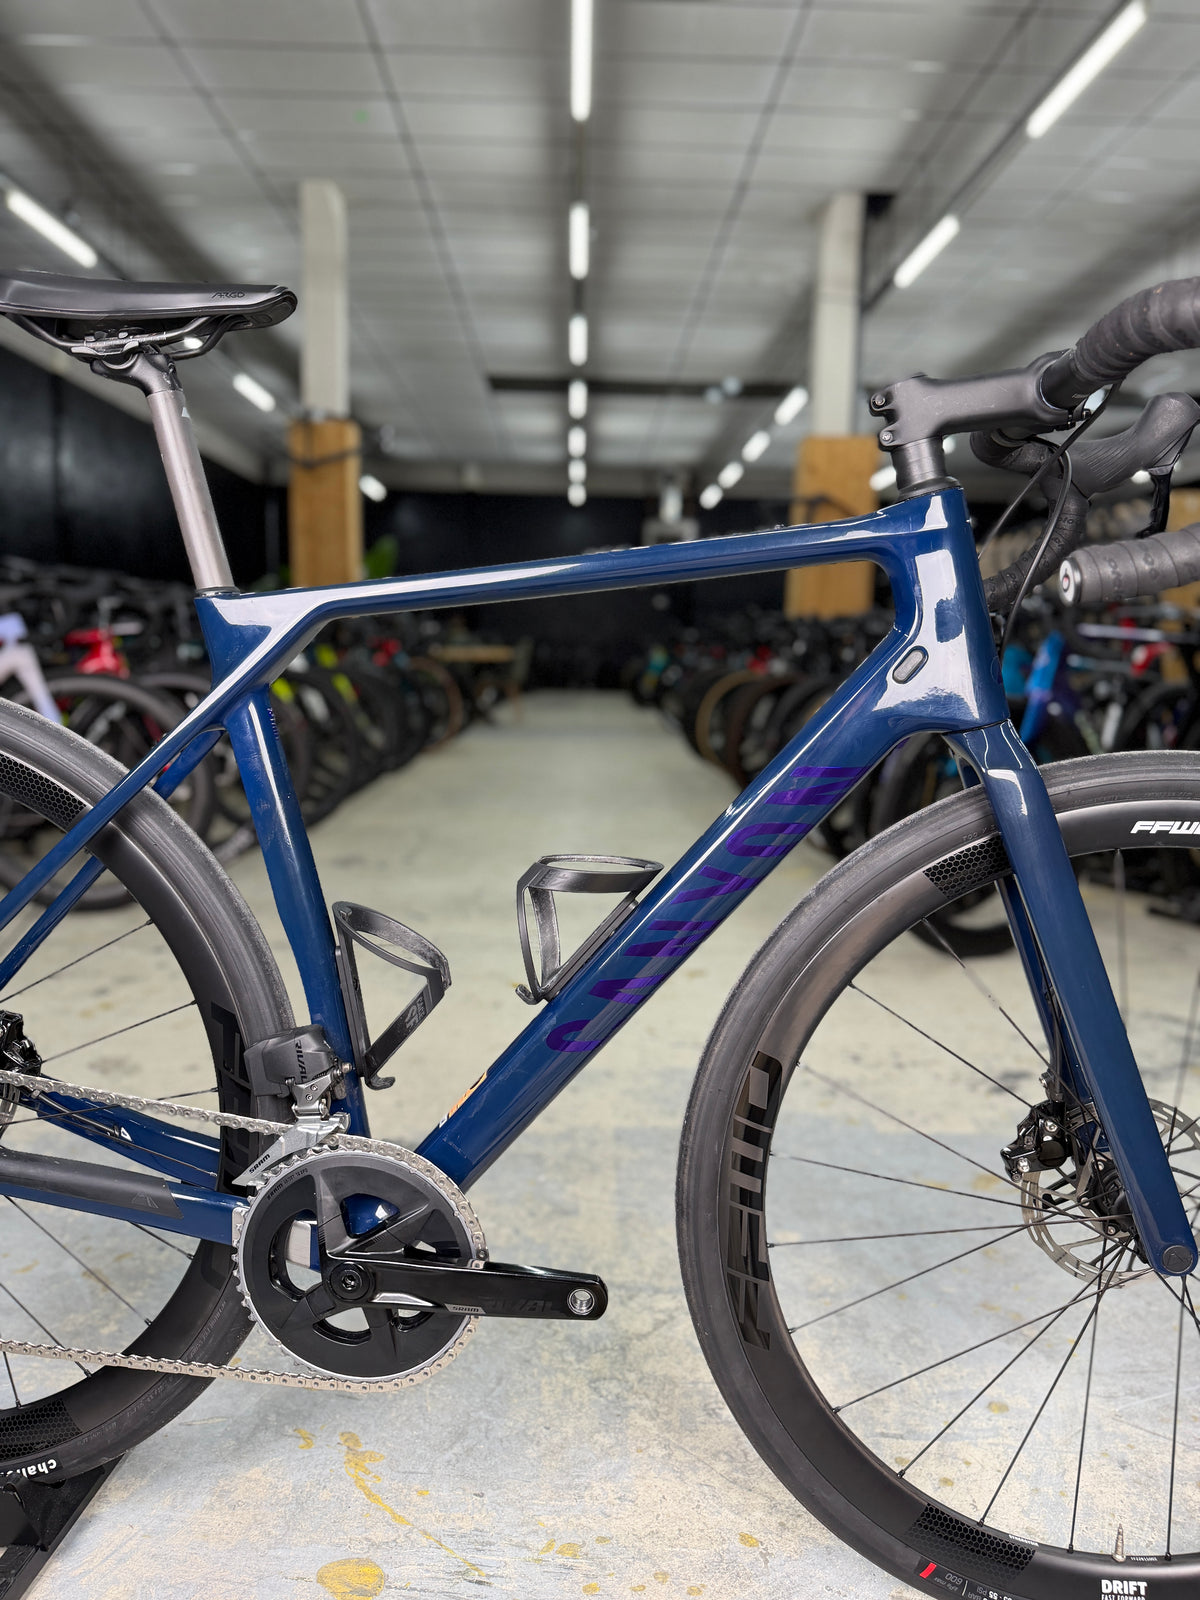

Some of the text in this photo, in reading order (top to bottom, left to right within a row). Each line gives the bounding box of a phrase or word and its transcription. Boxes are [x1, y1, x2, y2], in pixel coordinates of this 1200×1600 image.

[211, 291, 245, 299] ARGO
[546, 766, 869, 1053] CANYON
[295, 1040, 308, 1083] RIVAL
[249, 1153, 271, 1174] SRAM
[727, 1051, 782, 1350] FFWD
[452, 1306, 480, 1314] SRAM
[945, 1572, 963, 1585] 600
[1101, 1579, 1148, 1596] DRIFT
